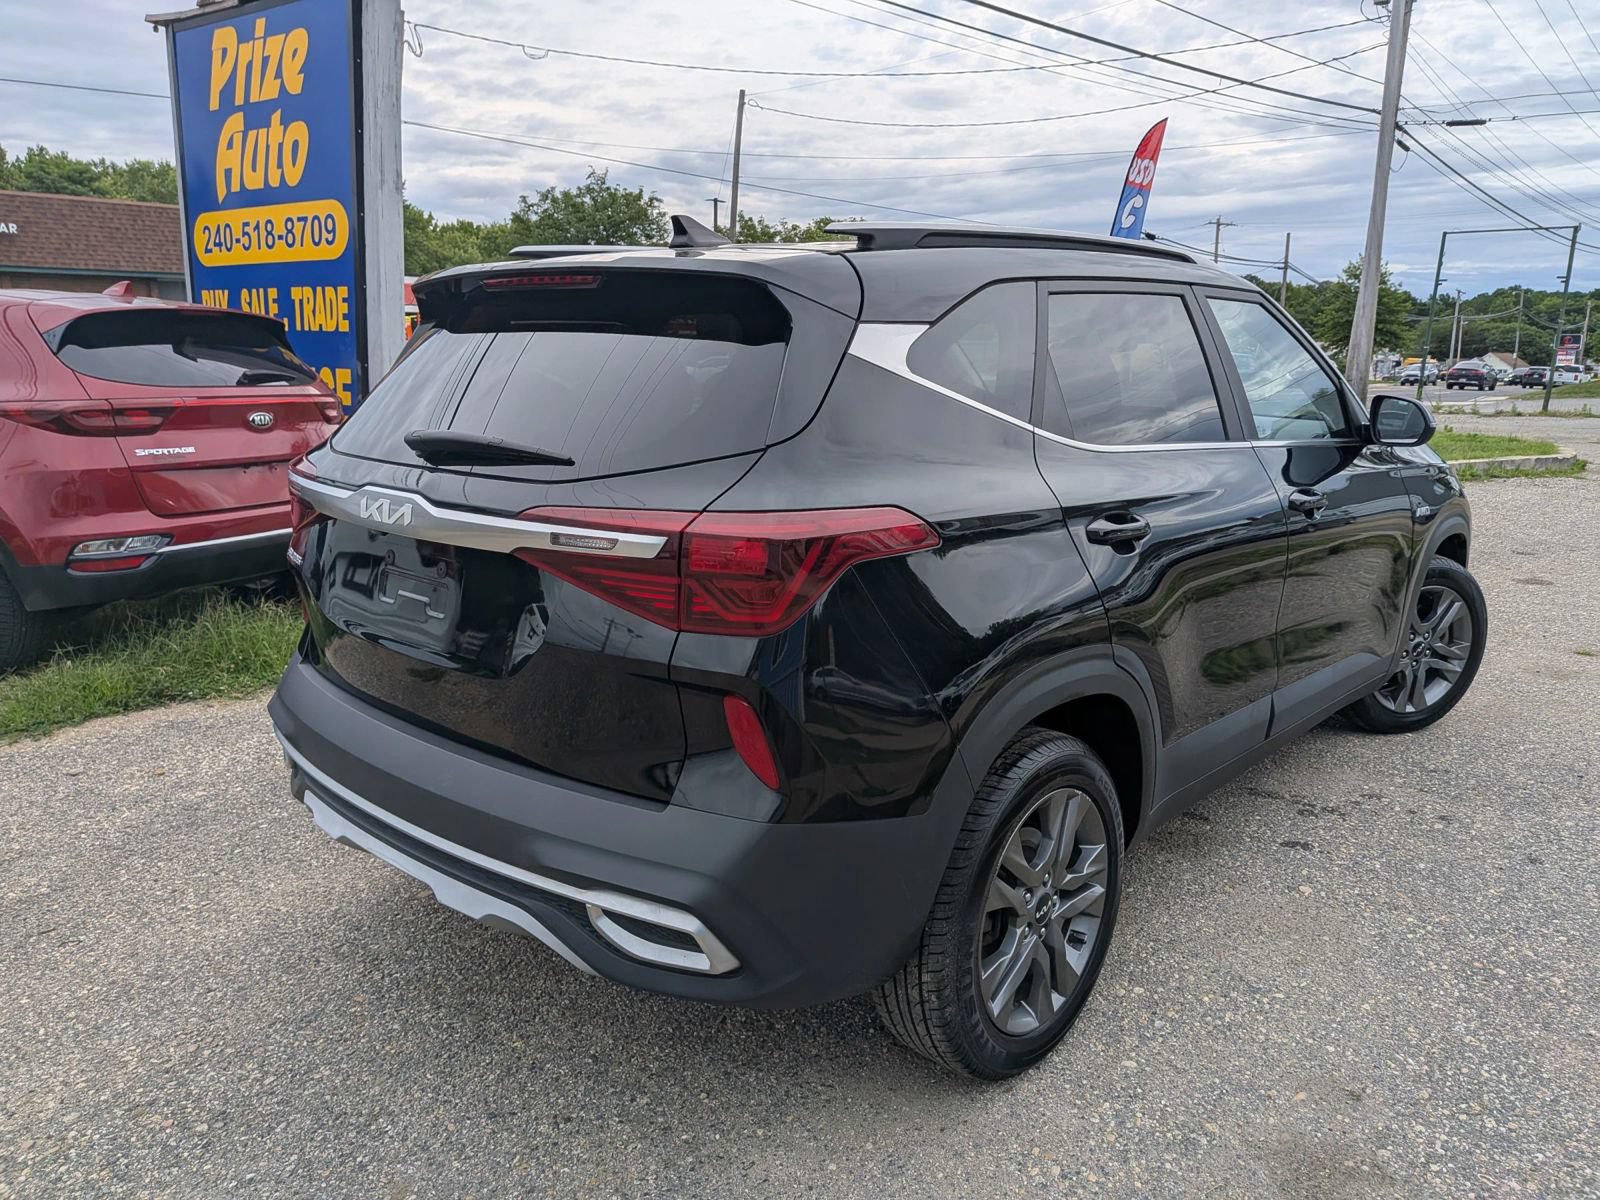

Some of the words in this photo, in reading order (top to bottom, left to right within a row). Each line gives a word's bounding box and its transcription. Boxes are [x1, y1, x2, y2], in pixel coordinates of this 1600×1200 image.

[209, 17, 309, 111] Prize
[216, 108, 309, 205] Auto
[202, 213, 337, 254] 240-518-8709
[291, 286, 349, 332] TRADE
[134, 446, 196, 457] SPORTAGE
